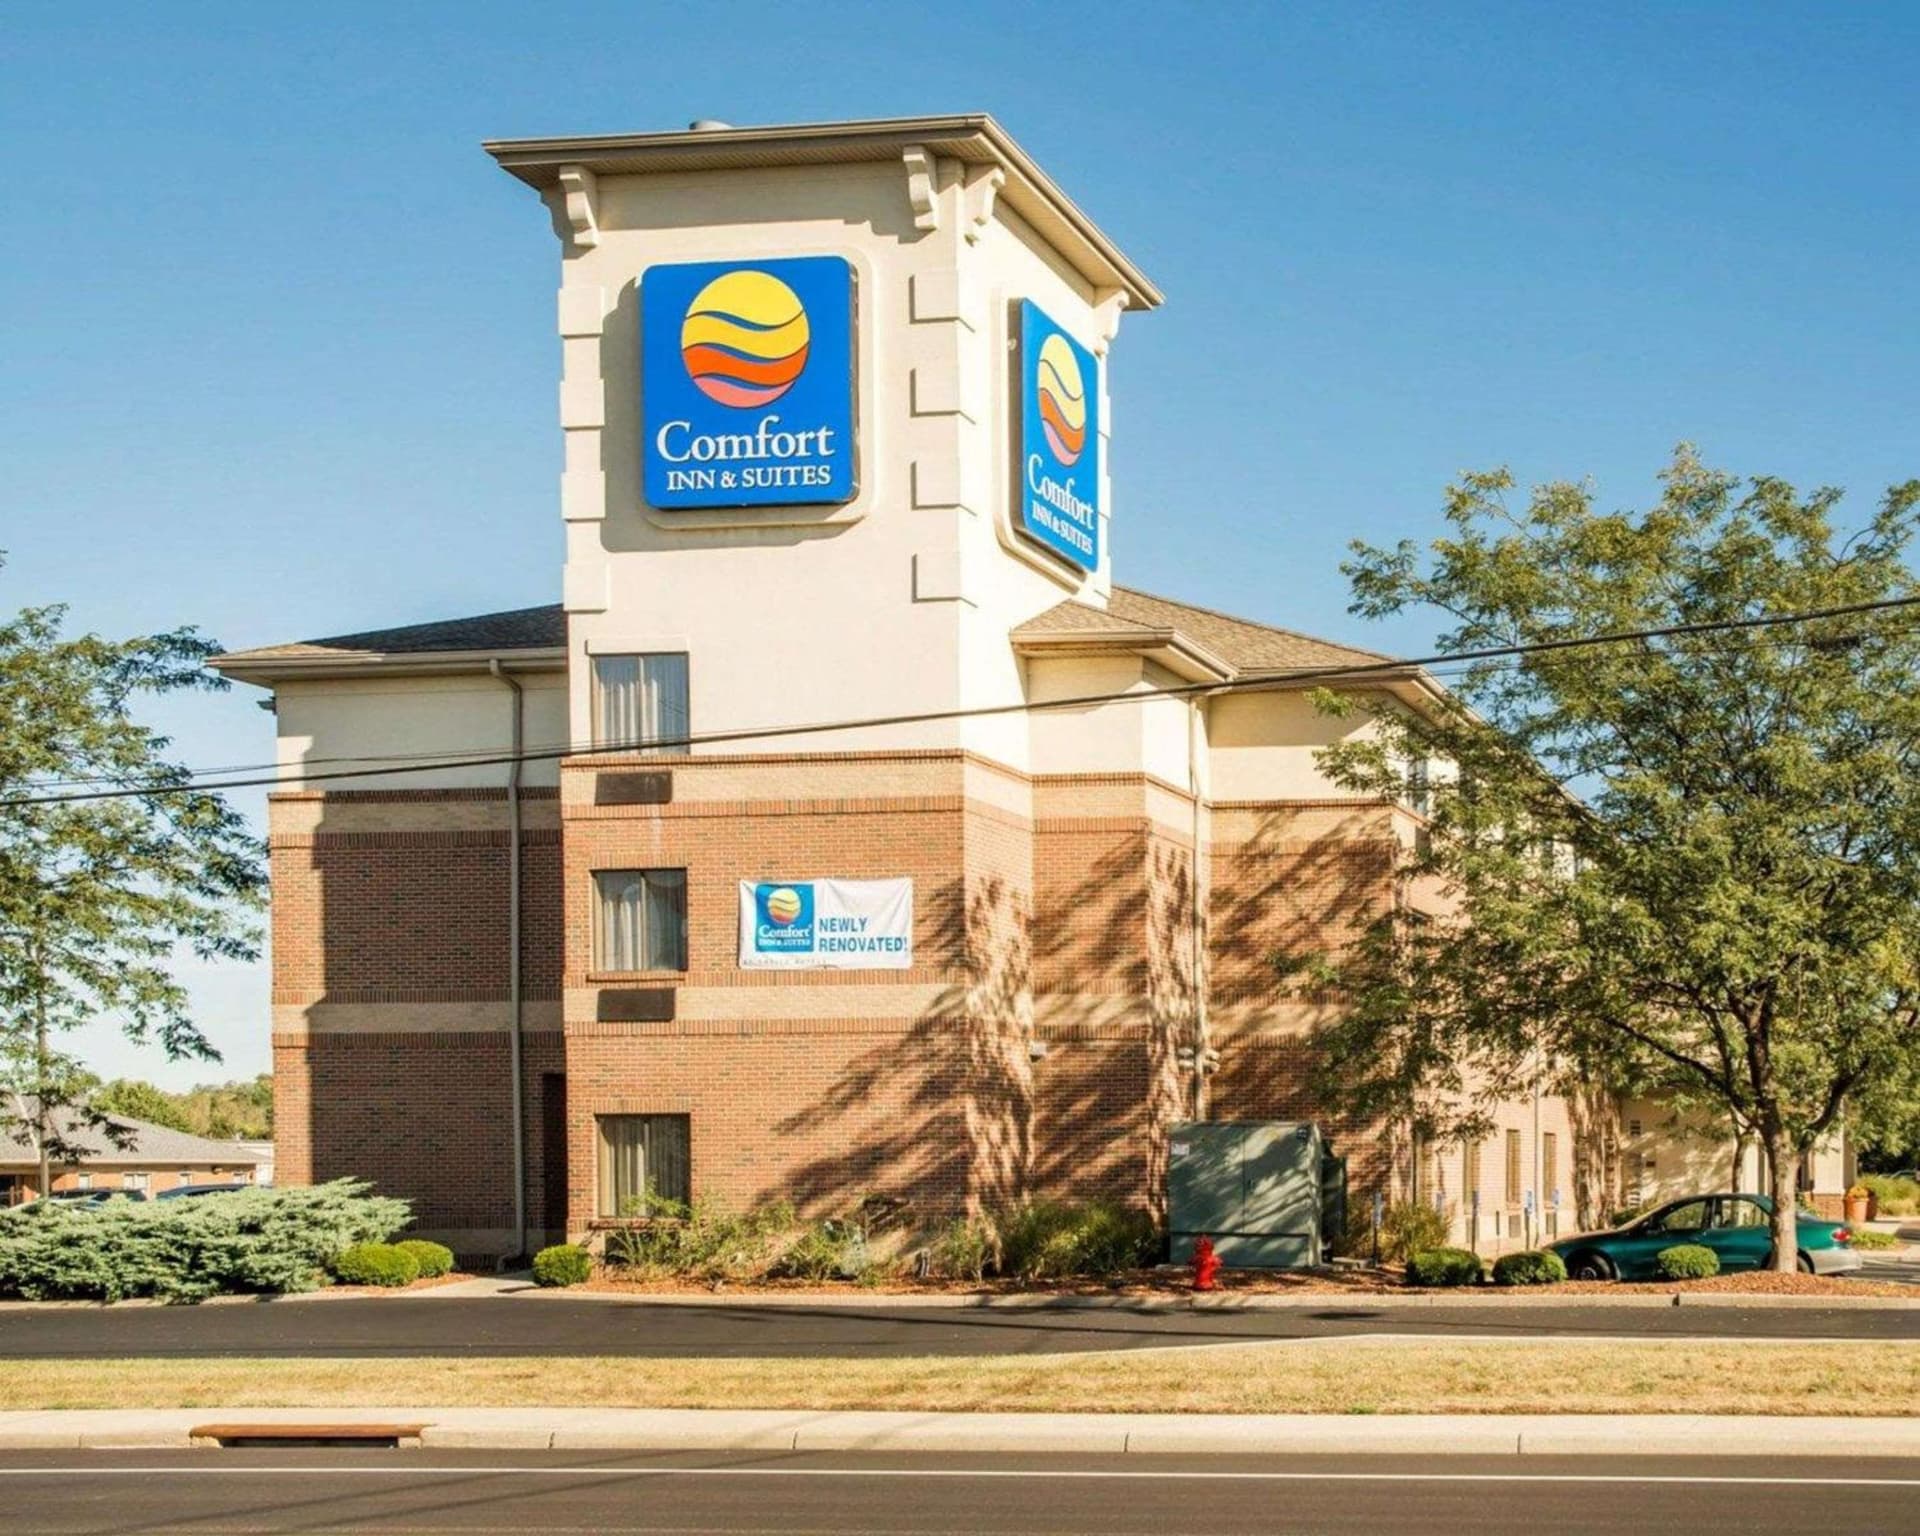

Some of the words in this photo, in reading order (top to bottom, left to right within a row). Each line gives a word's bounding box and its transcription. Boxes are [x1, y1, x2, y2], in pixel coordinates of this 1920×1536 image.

[657, 415, 835, 462] Comfort
[667, 470, 716, 490] INN
[720, 471, 738, 489] &
[742, 465, 831, 488] SUITES
[1028, 453, 1094, 530] Comfort
[1031, 499, 1053, 529] INN
[1059, 518, 1093, 555] SUITES
[758, 924, 810, 938] Comfort
[818, 918, 868, 932] NEWLY
[818, 937, 907, 952] RENOVATED!
